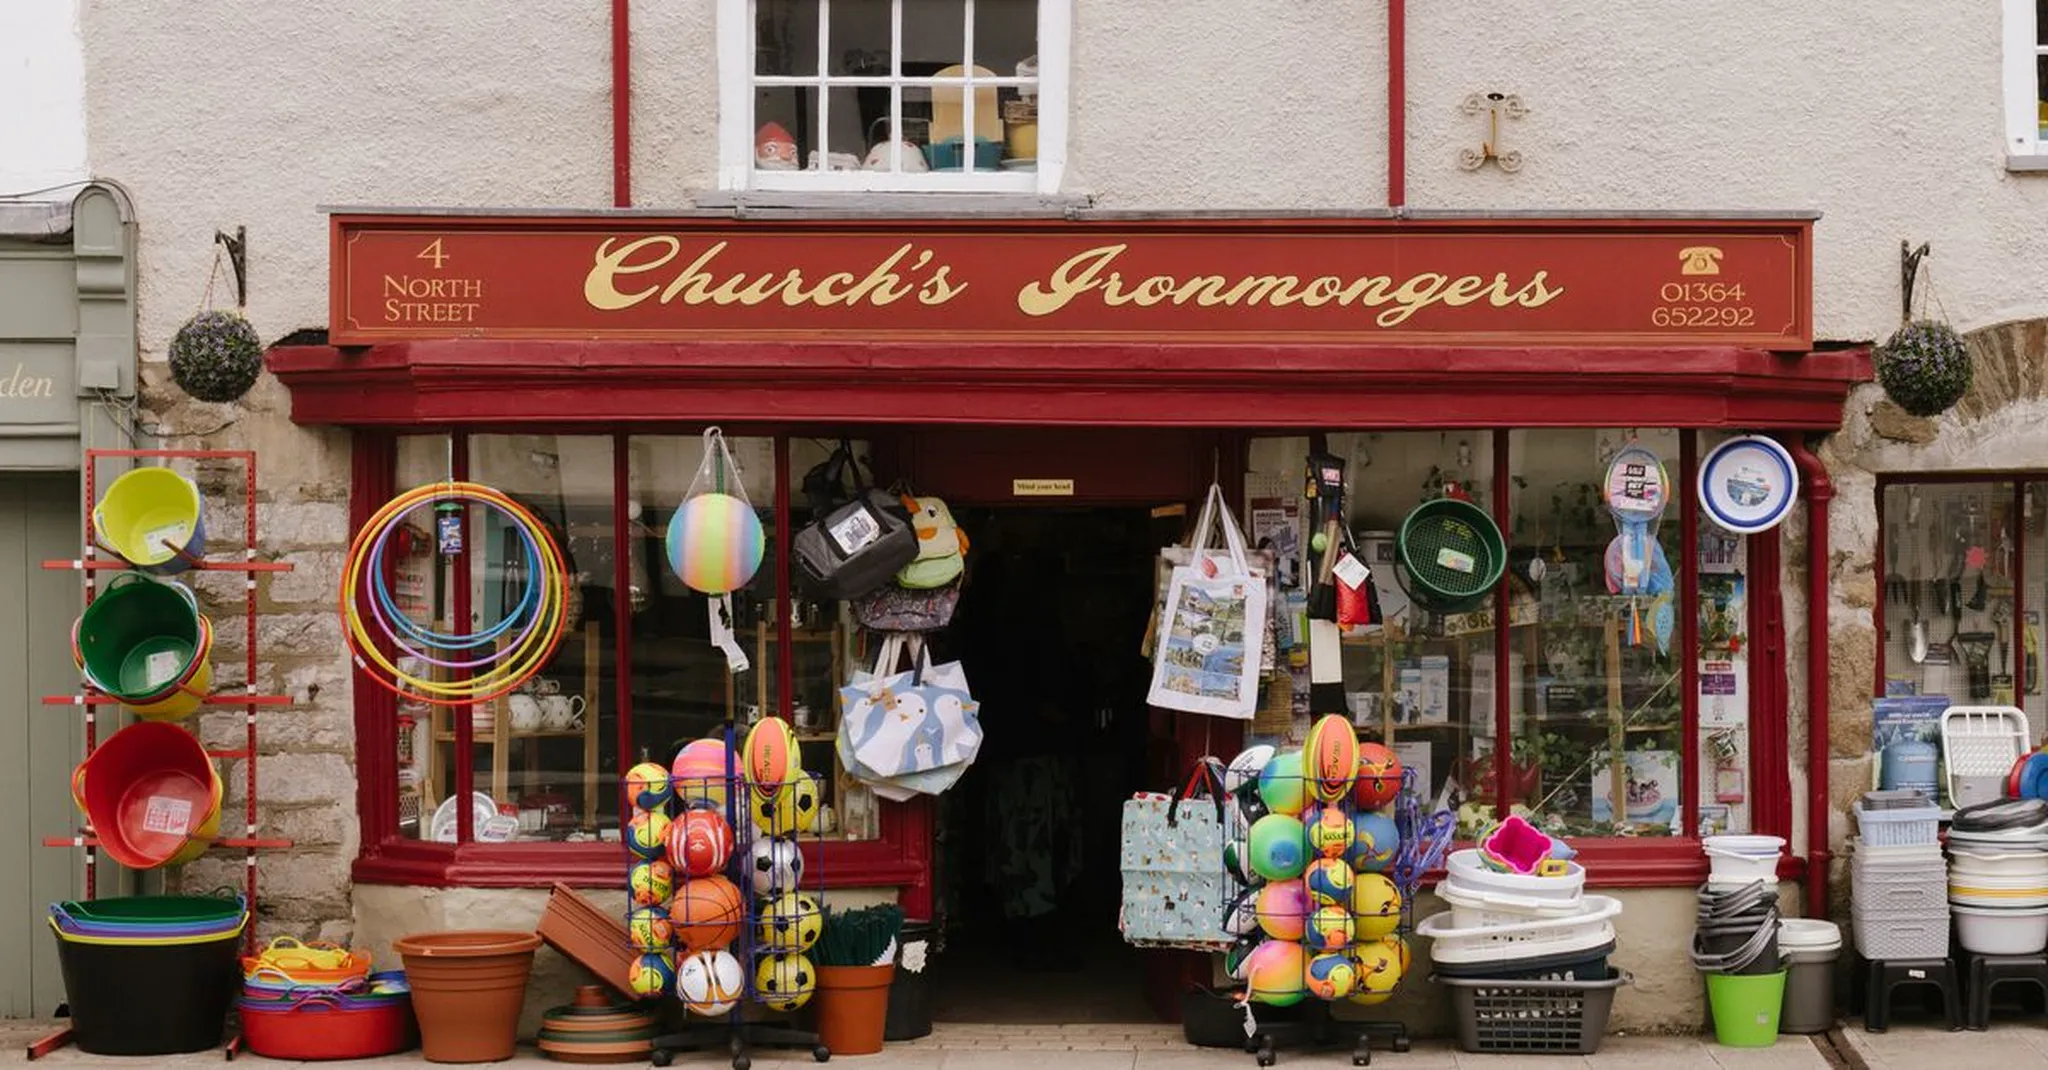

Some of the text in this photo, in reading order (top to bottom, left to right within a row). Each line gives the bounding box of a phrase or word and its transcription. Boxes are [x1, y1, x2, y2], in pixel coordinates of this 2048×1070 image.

[416, 237, 450, 269] 4
[384, 274, 482, 298] NORTH
[584, 234, 1564, 328] Church's Ironmongers
[1660, 282, 1747, 303] 01364
[384, 298, 481, 322] STREET
[1651, 306, 1756, 328] 652292
